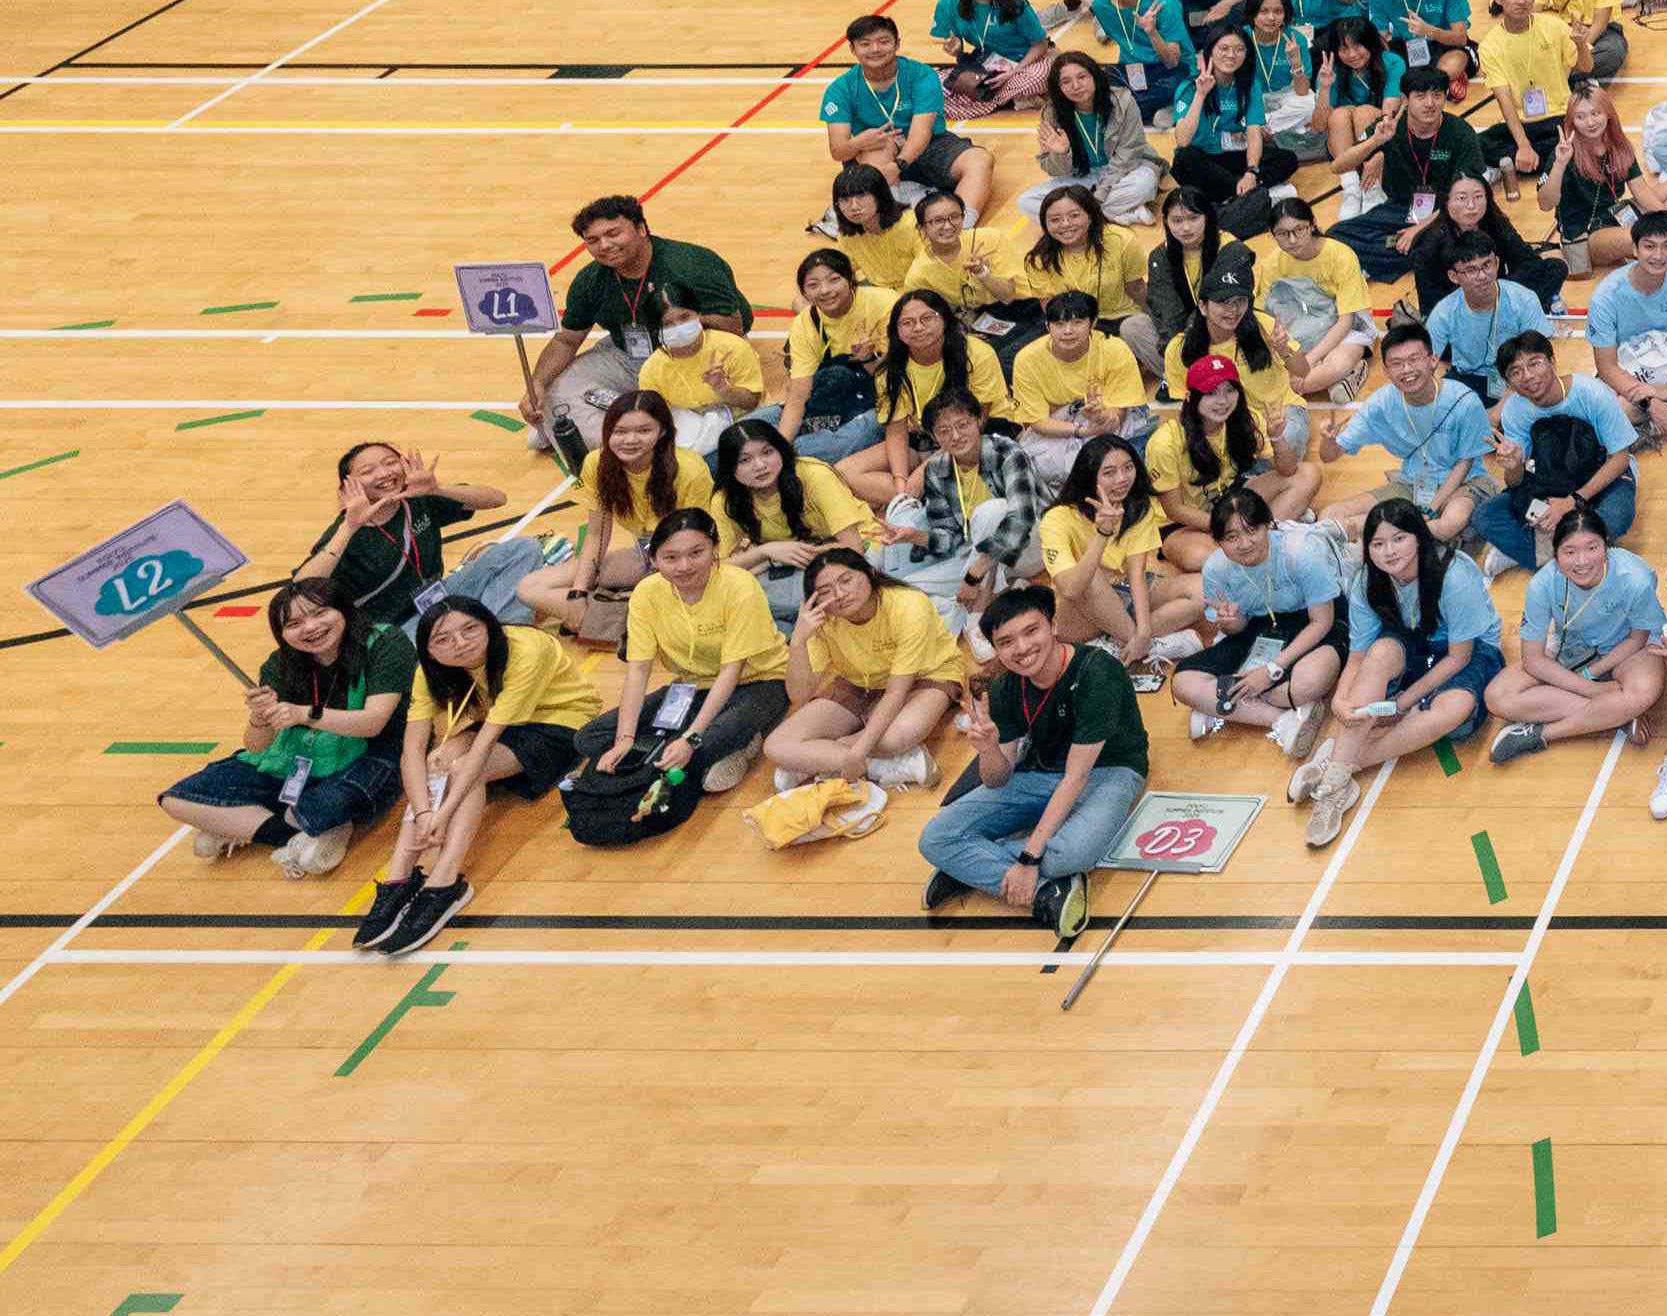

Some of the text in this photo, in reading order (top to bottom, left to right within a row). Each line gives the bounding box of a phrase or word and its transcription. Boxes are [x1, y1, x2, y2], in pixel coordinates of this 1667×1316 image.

[492, 292, 520, 319] L1
[113, 558, 175, 612] L2
[1143, 825, 1204, 855] D3
